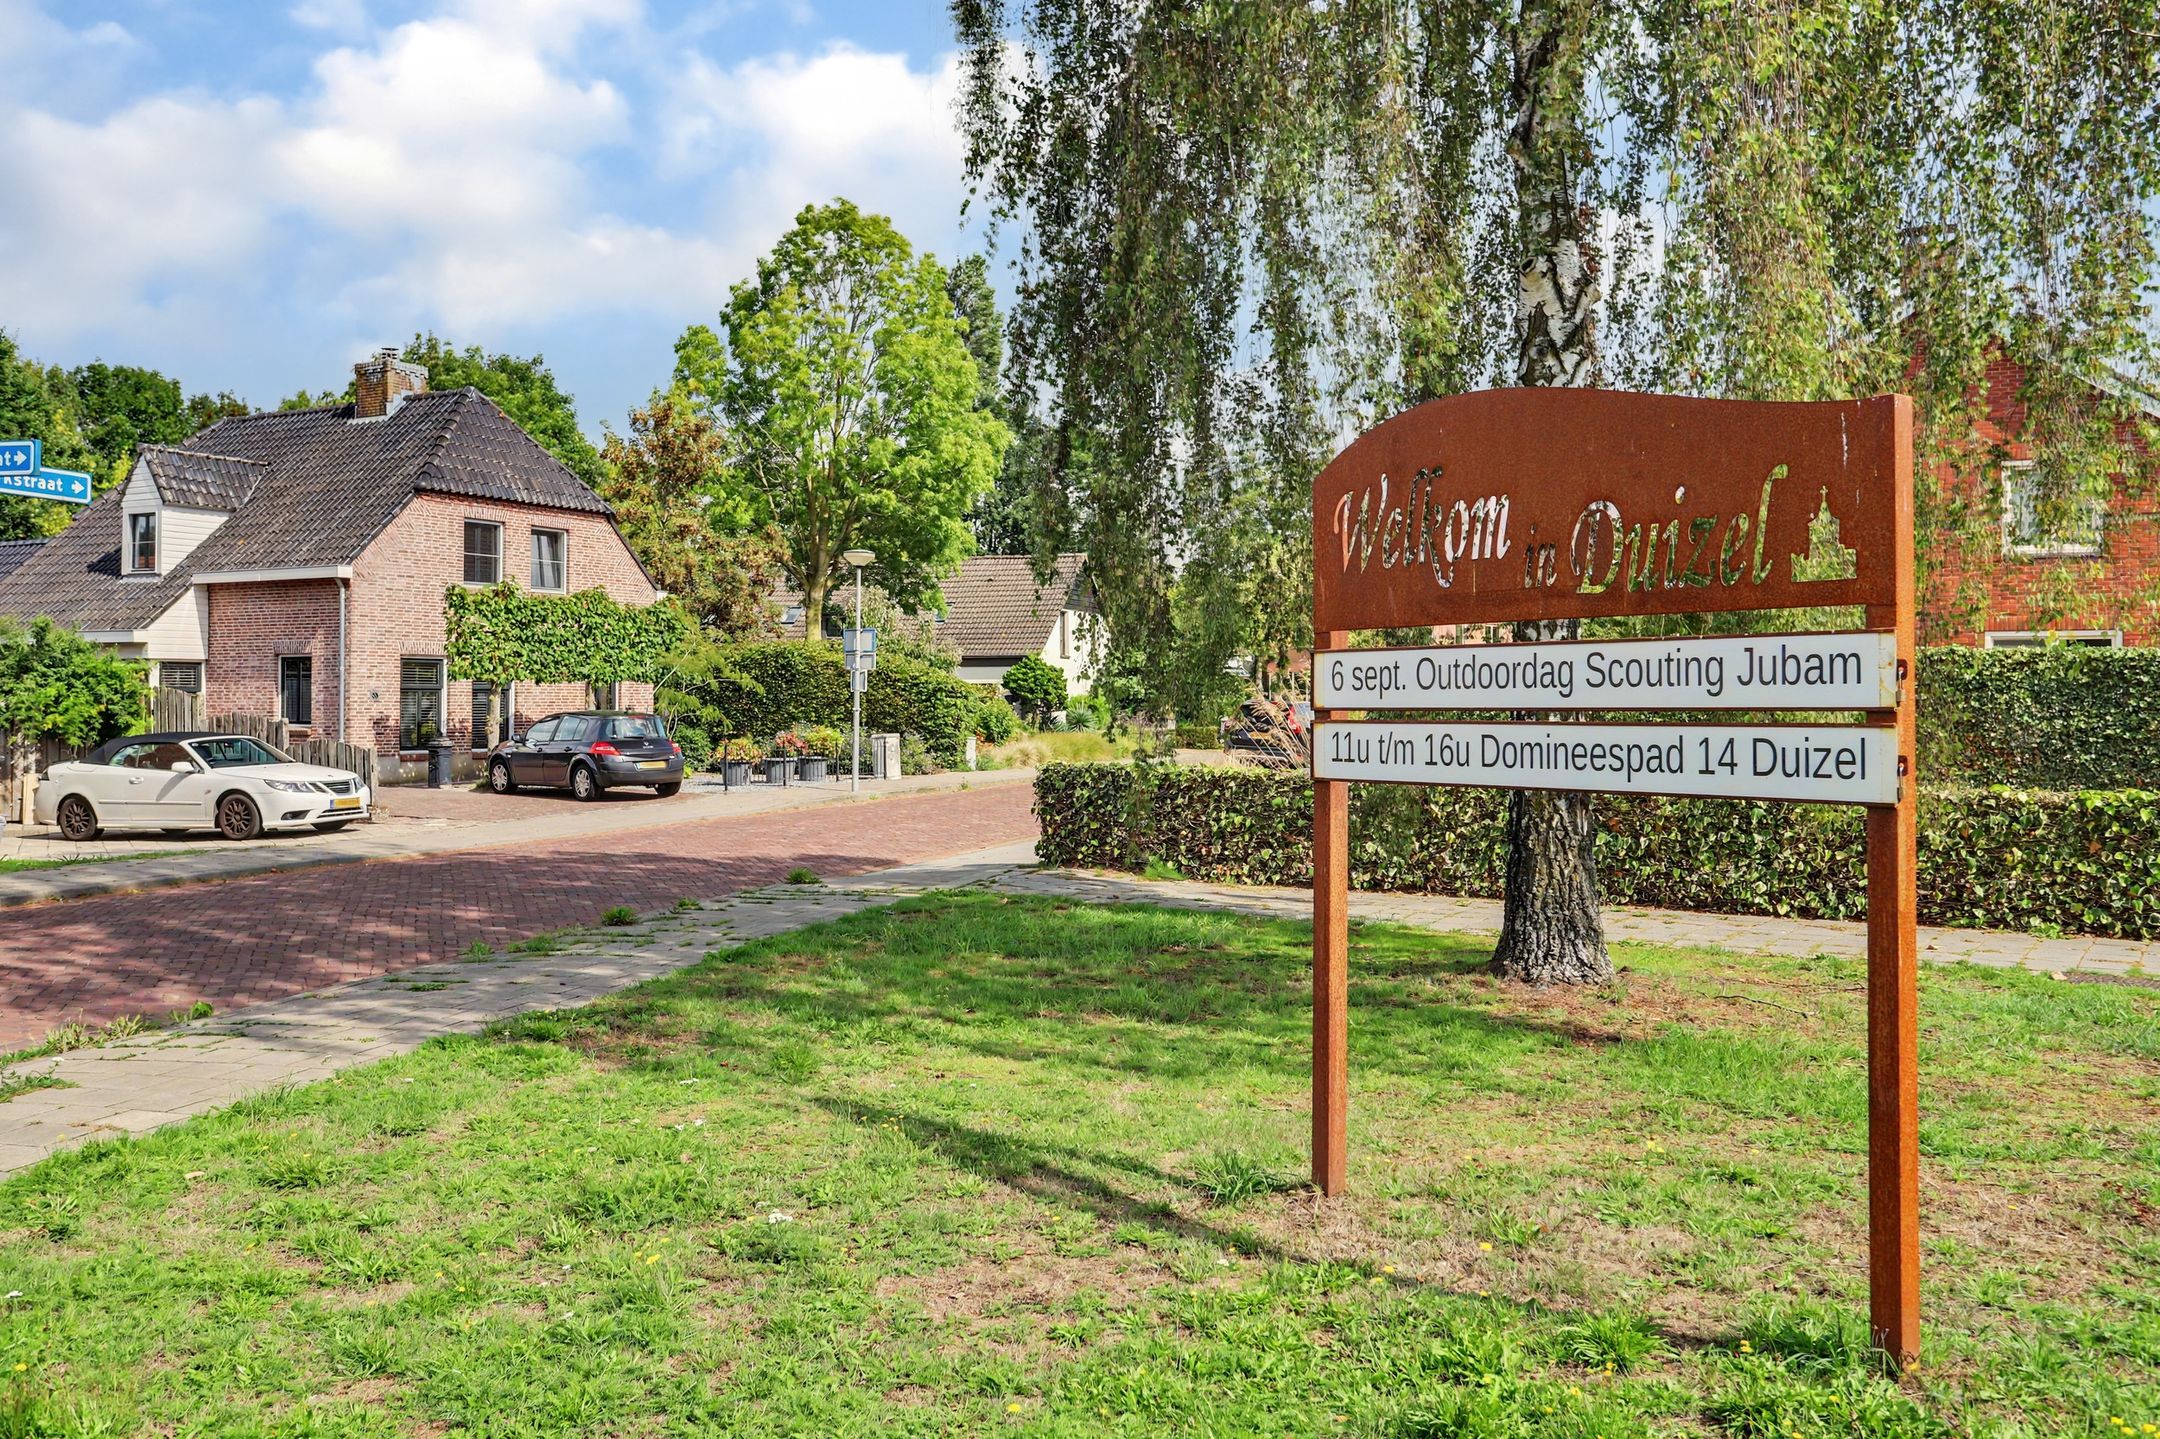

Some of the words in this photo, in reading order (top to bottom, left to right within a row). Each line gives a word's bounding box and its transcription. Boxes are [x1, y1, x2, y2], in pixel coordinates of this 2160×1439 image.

[1333, 466, 1511, 588] Welkom
[1524, 524, 1558, 588] in
[1570, 463, 1789, 594] Duizel
[1331, 660, 1344, 692] 6
[1351, 660, 1407, 699] sept.
[1416, 652, 1574, 699] Outdoordag
[1585, 651, 1724, 698] Scouting
[1736, 644, 1862, 687] Jubam
[1331, 731, 1370, 764] 11u
[1377, 731, 1415, 766] t/m
[1424, 733, 1470, 768] 16u
[1480, 733, 1684, 784] Domineespad
[1698, 736, 1738, 776] 14
[1752, 737, 1866, 781] Duizel
